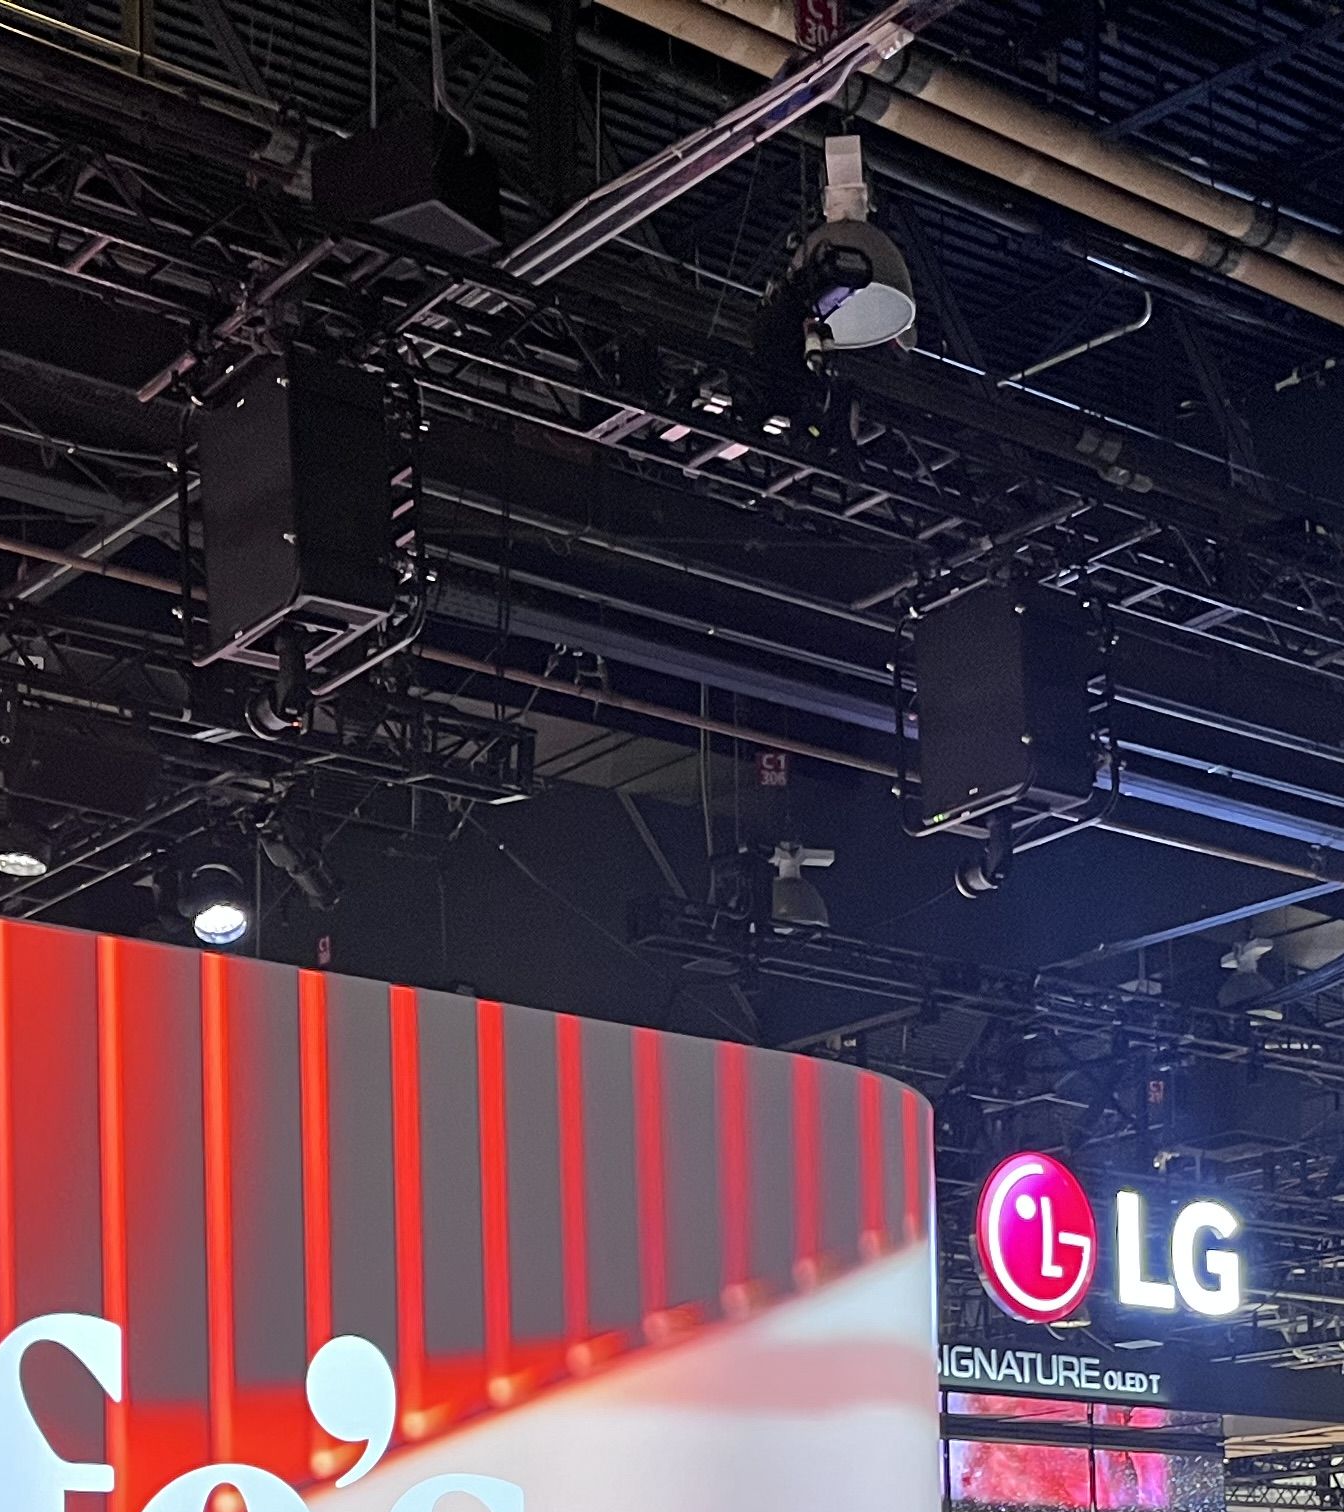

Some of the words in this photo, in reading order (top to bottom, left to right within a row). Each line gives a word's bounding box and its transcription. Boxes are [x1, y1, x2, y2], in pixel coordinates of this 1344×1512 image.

[762, 754, 786, 769] C1
[1115, 1190, 1242, 1316] LG
[938, 1343, 1101, 1390] IGNATURE
[1103, 1370, 1148, 1393] OLED
[1149, 1374, 1161, 1394] T
